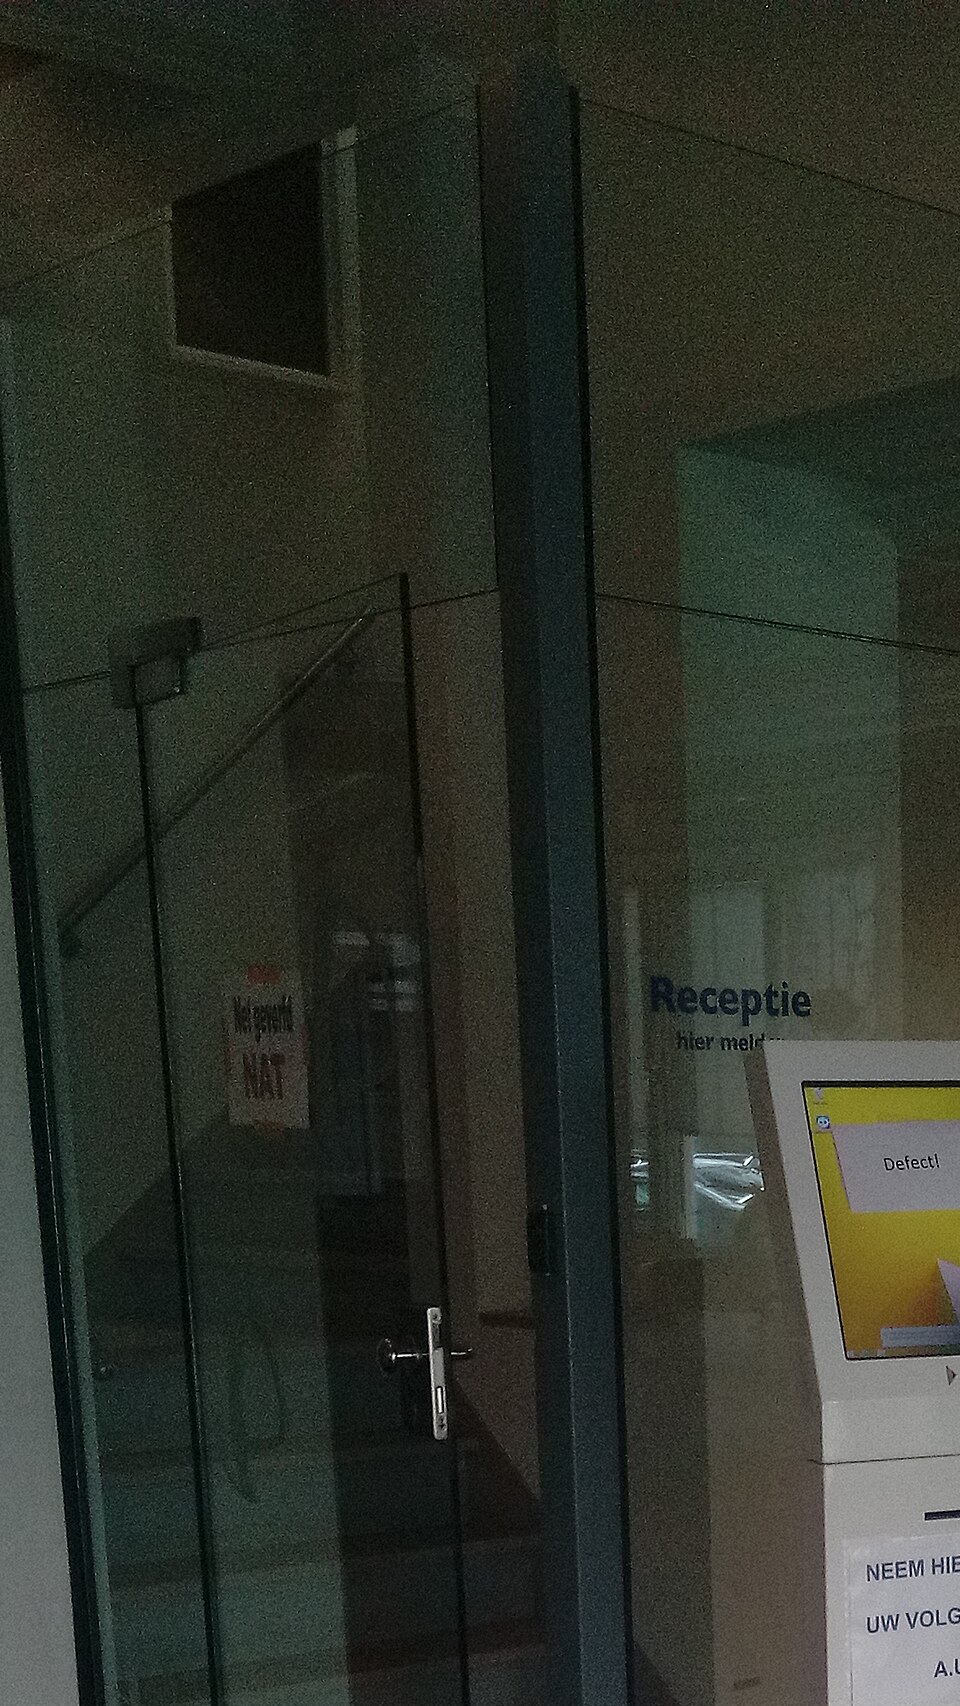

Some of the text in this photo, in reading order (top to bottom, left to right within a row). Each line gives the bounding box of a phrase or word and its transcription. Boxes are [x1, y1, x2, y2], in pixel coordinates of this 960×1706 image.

[650, 976, 811, 1026] Receptie
[678, 1031, 714, 1050] hier
[242, 1052, 285, 1100] NAT
[883, 1153, 940, 1171] Defect!
[866, 1559, 925, 1582] NEEM
[866, 1614, 900, 1634] UW
